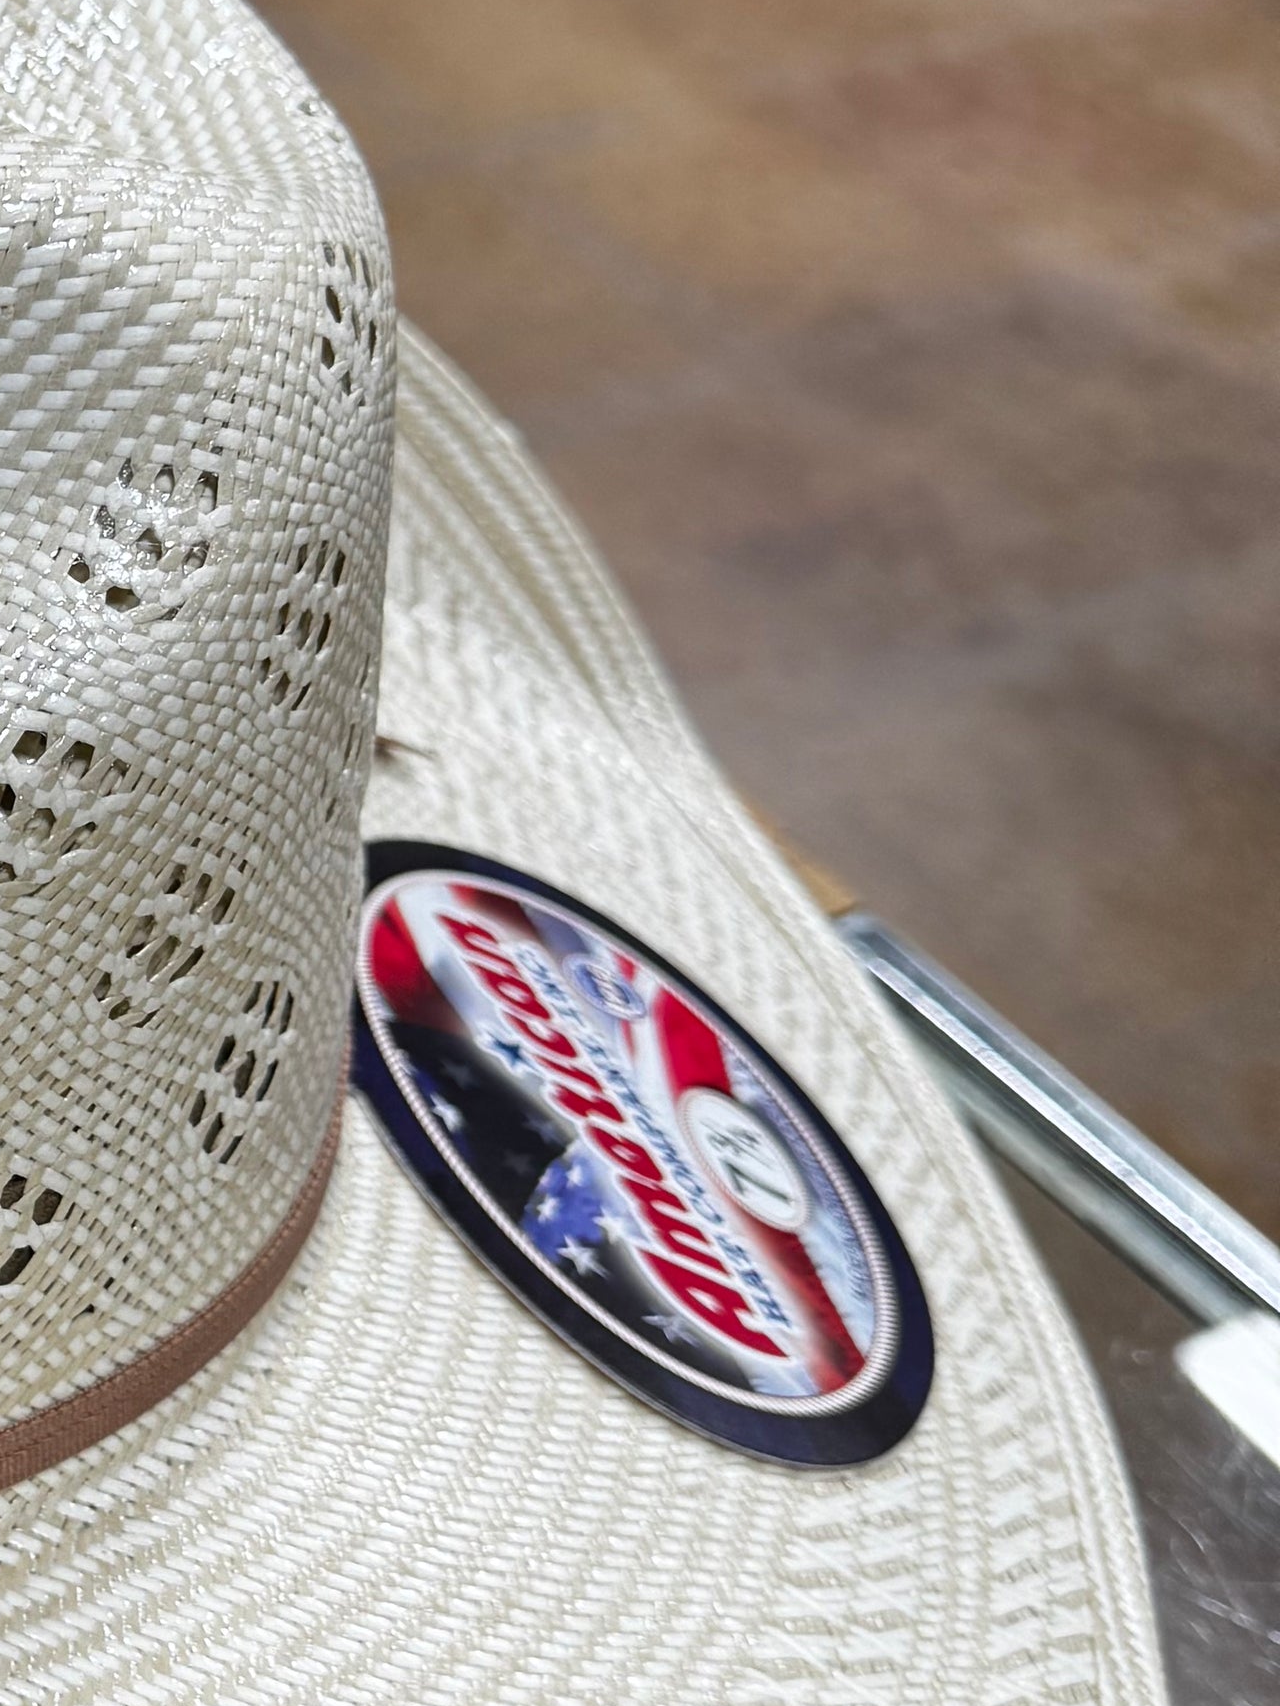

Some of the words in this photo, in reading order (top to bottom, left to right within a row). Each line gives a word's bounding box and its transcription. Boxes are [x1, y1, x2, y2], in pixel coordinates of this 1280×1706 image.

[435, 912, 790, 1359] American
[578, 1033, 724, 1225] COMPANY
[715, 1231, 792, 1328] HAT
